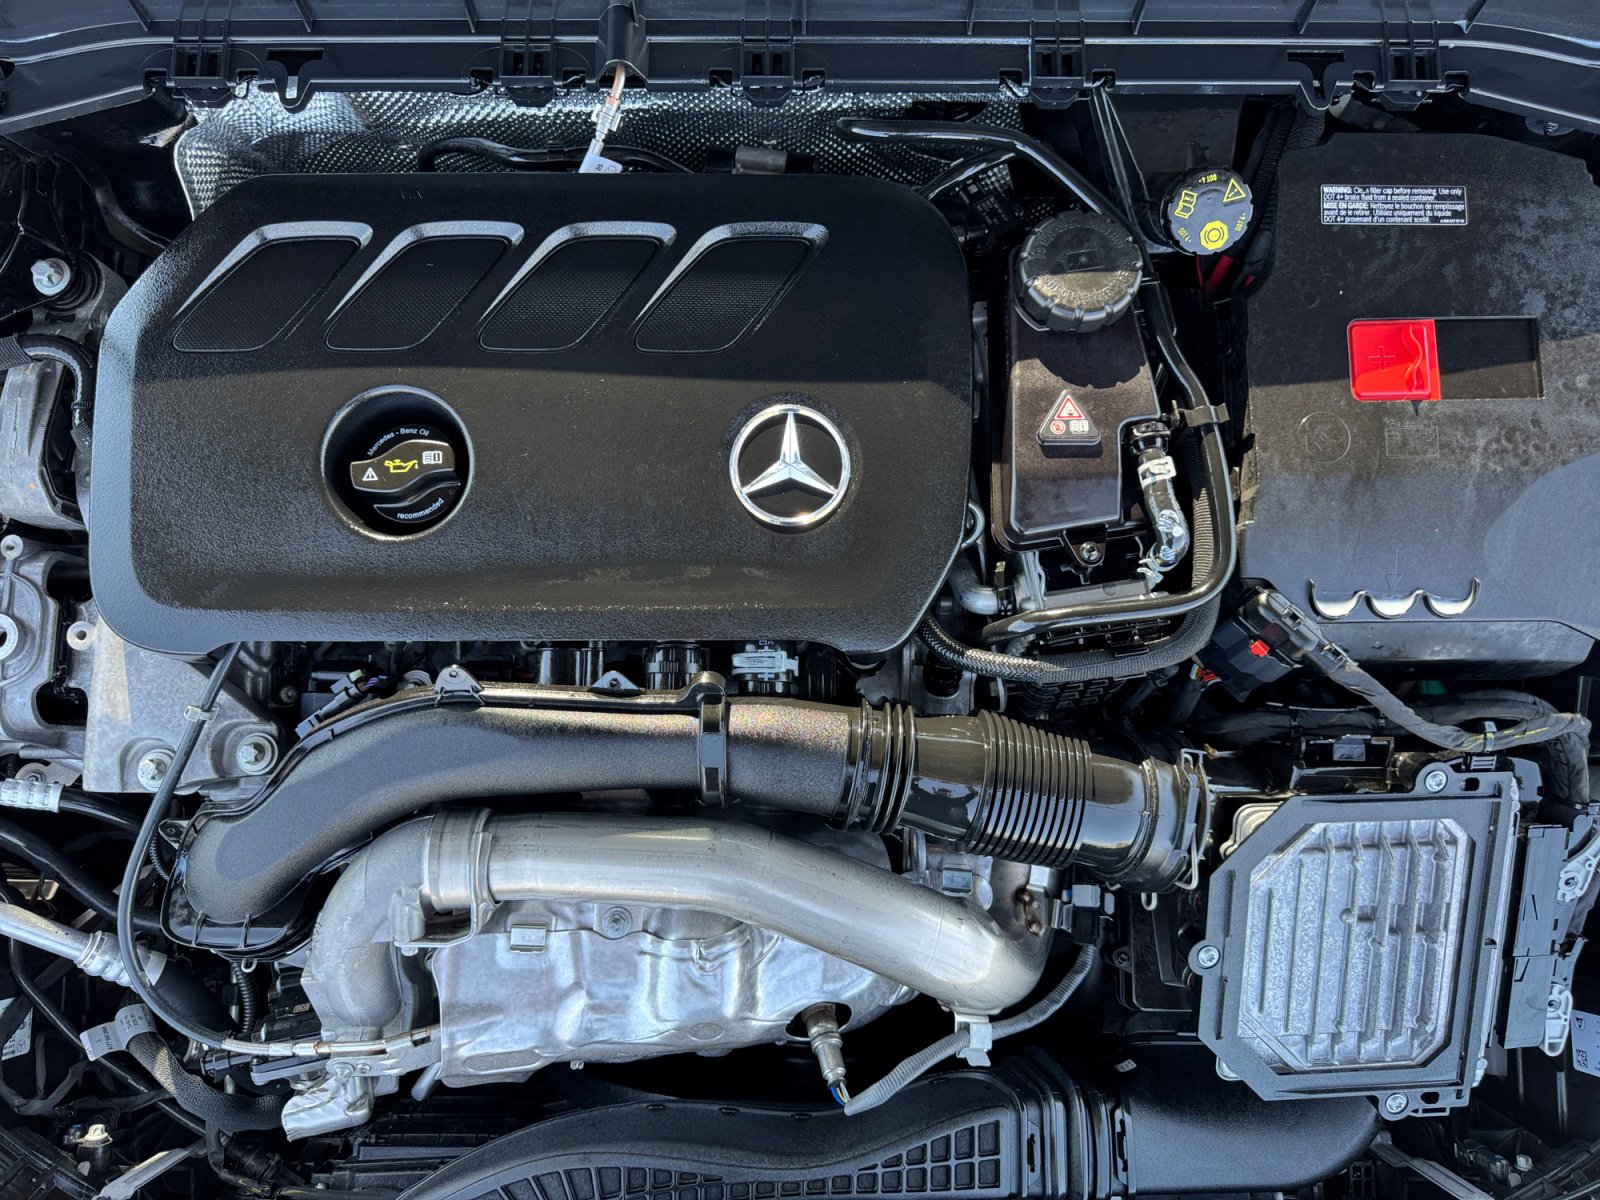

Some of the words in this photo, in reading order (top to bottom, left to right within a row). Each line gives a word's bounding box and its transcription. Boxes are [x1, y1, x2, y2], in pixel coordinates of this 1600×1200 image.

[1412, 188, 1437, 196] removing.
[1450, 188, 1462, 196] only
[1433, 203, 1465, 211] remplissage
[367, 431, 395, 456] Mercedes
[400, 427, 418, 435] Benz
[419, 428, 430, 437] Oil
[397, 497, 445, 519] recommended
